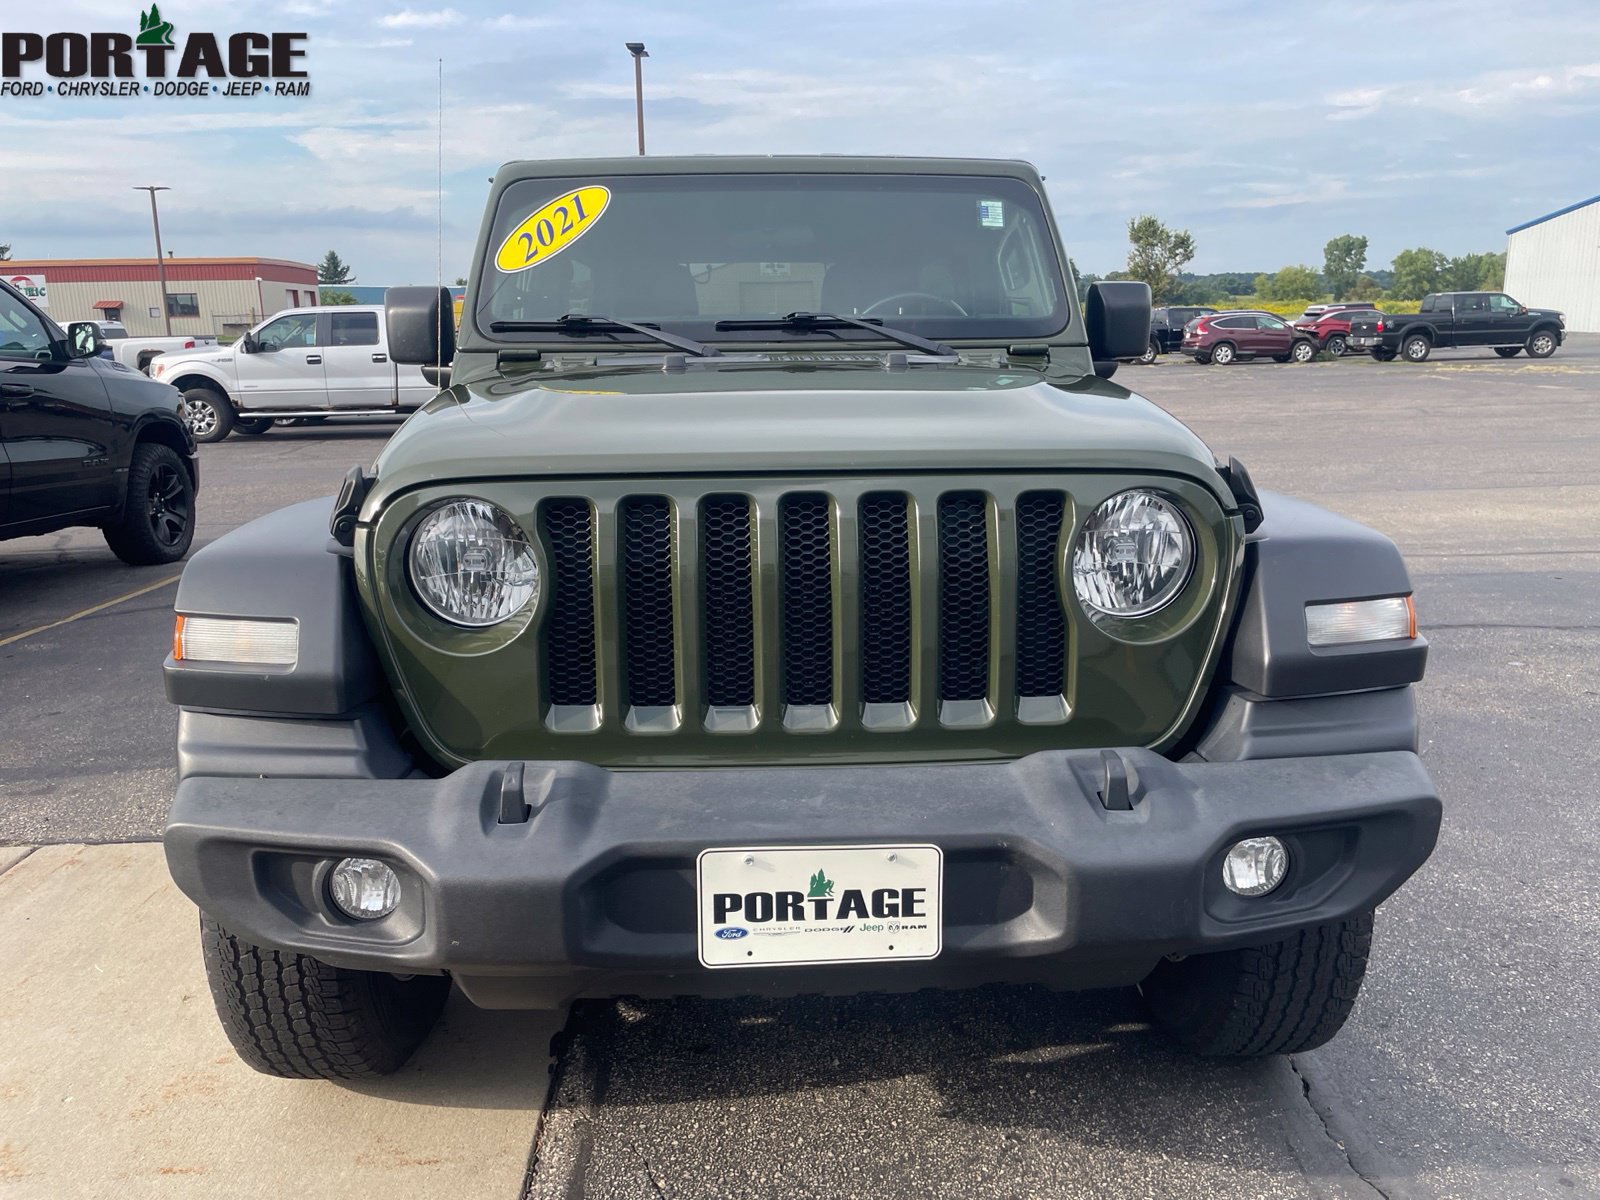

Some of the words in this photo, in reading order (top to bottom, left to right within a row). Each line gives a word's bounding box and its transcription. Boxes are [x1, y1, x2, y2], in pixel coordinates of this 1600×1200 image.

[517, 193, 590, 263] 2021
[713, 887, 927, 925] PORTAGE
[860, 923, 884, 933] Jeep
